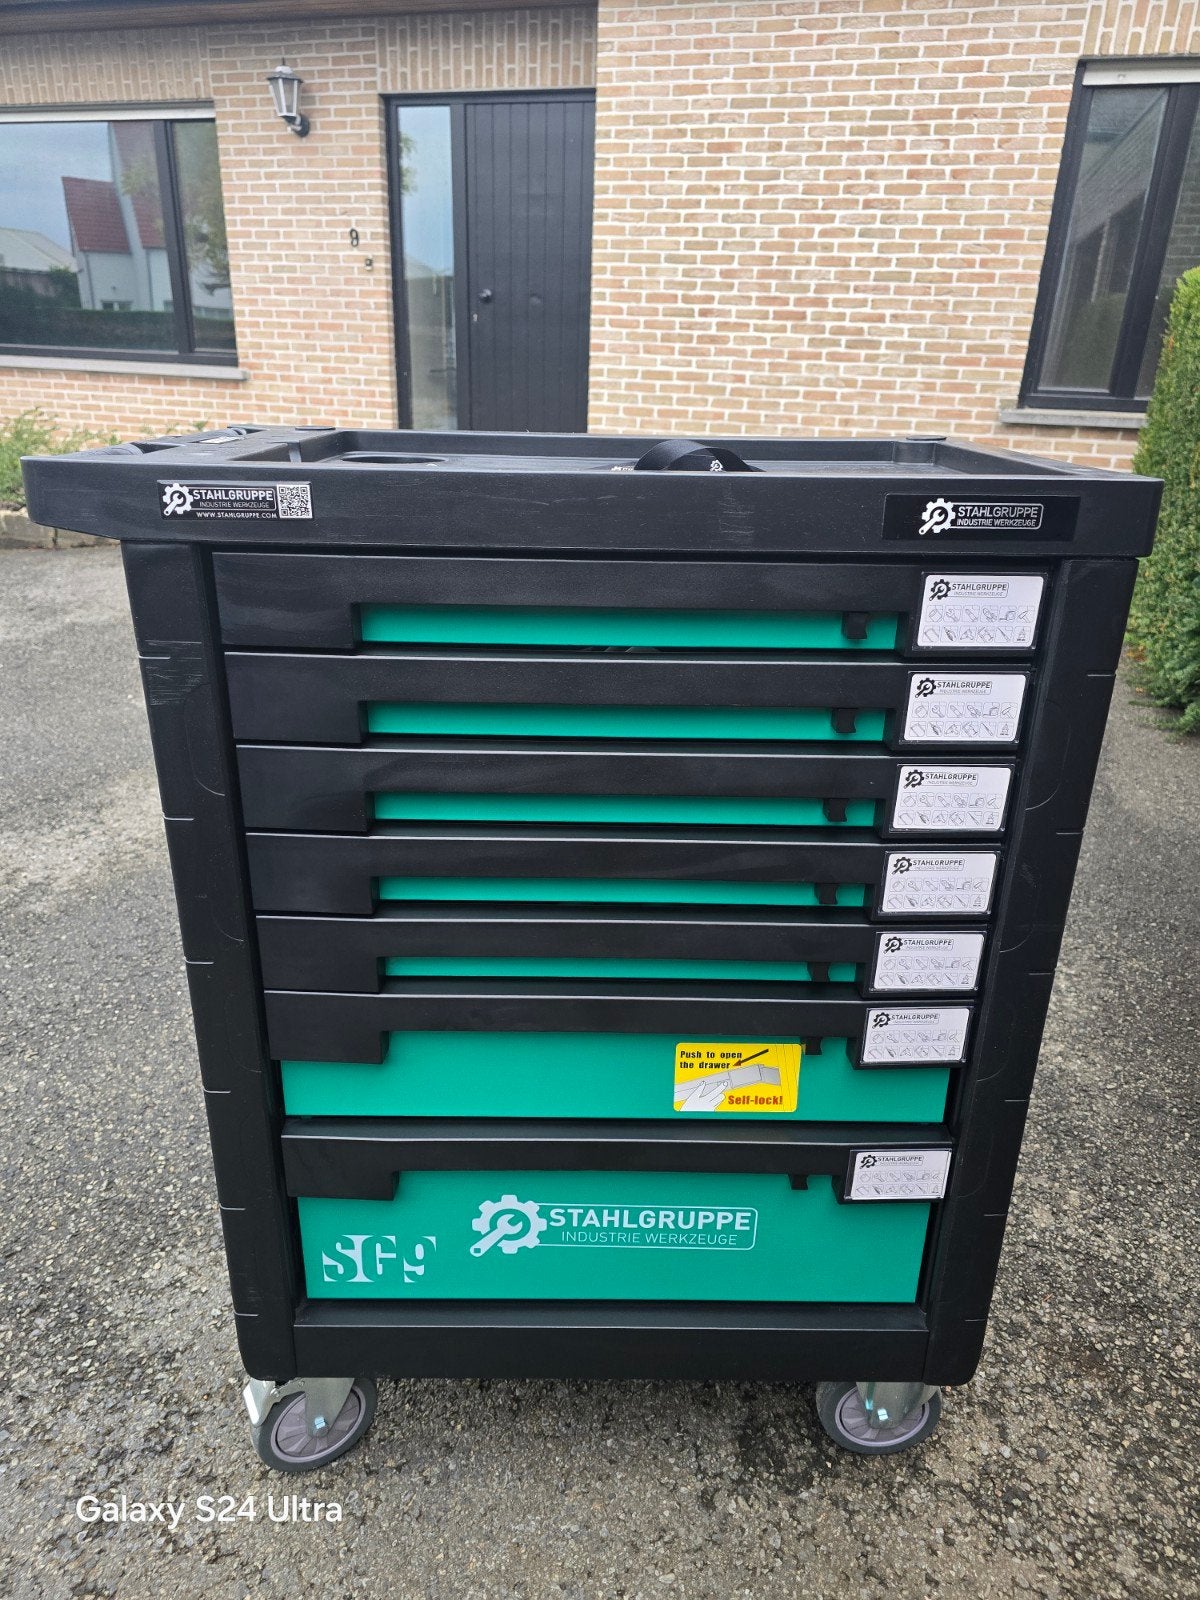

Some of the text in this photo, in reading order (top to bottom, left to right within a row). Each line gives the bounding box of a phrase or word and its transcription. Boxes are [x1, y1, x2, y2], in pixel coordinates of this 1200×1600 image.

[193, 490, 273, 501] STAHLGRUPPE
[958, 506, 1039, 518] STAHLGRUPPE
[957, 518, 1036, 527] INDUSTRIE WERKZEUGE
[952, 583, 1007, 591] STAHLGRUPPE
[680, 1050, 701, 1059] Push
[720, 1051, 742, 1059] open
[728, 1095, 783, 1105] Self-lock!
[549, 1208, 752, 1231] STAHLGRUPPE
[561, 1231, 738, 1246] INDUSTRIE WERKZEUGE
